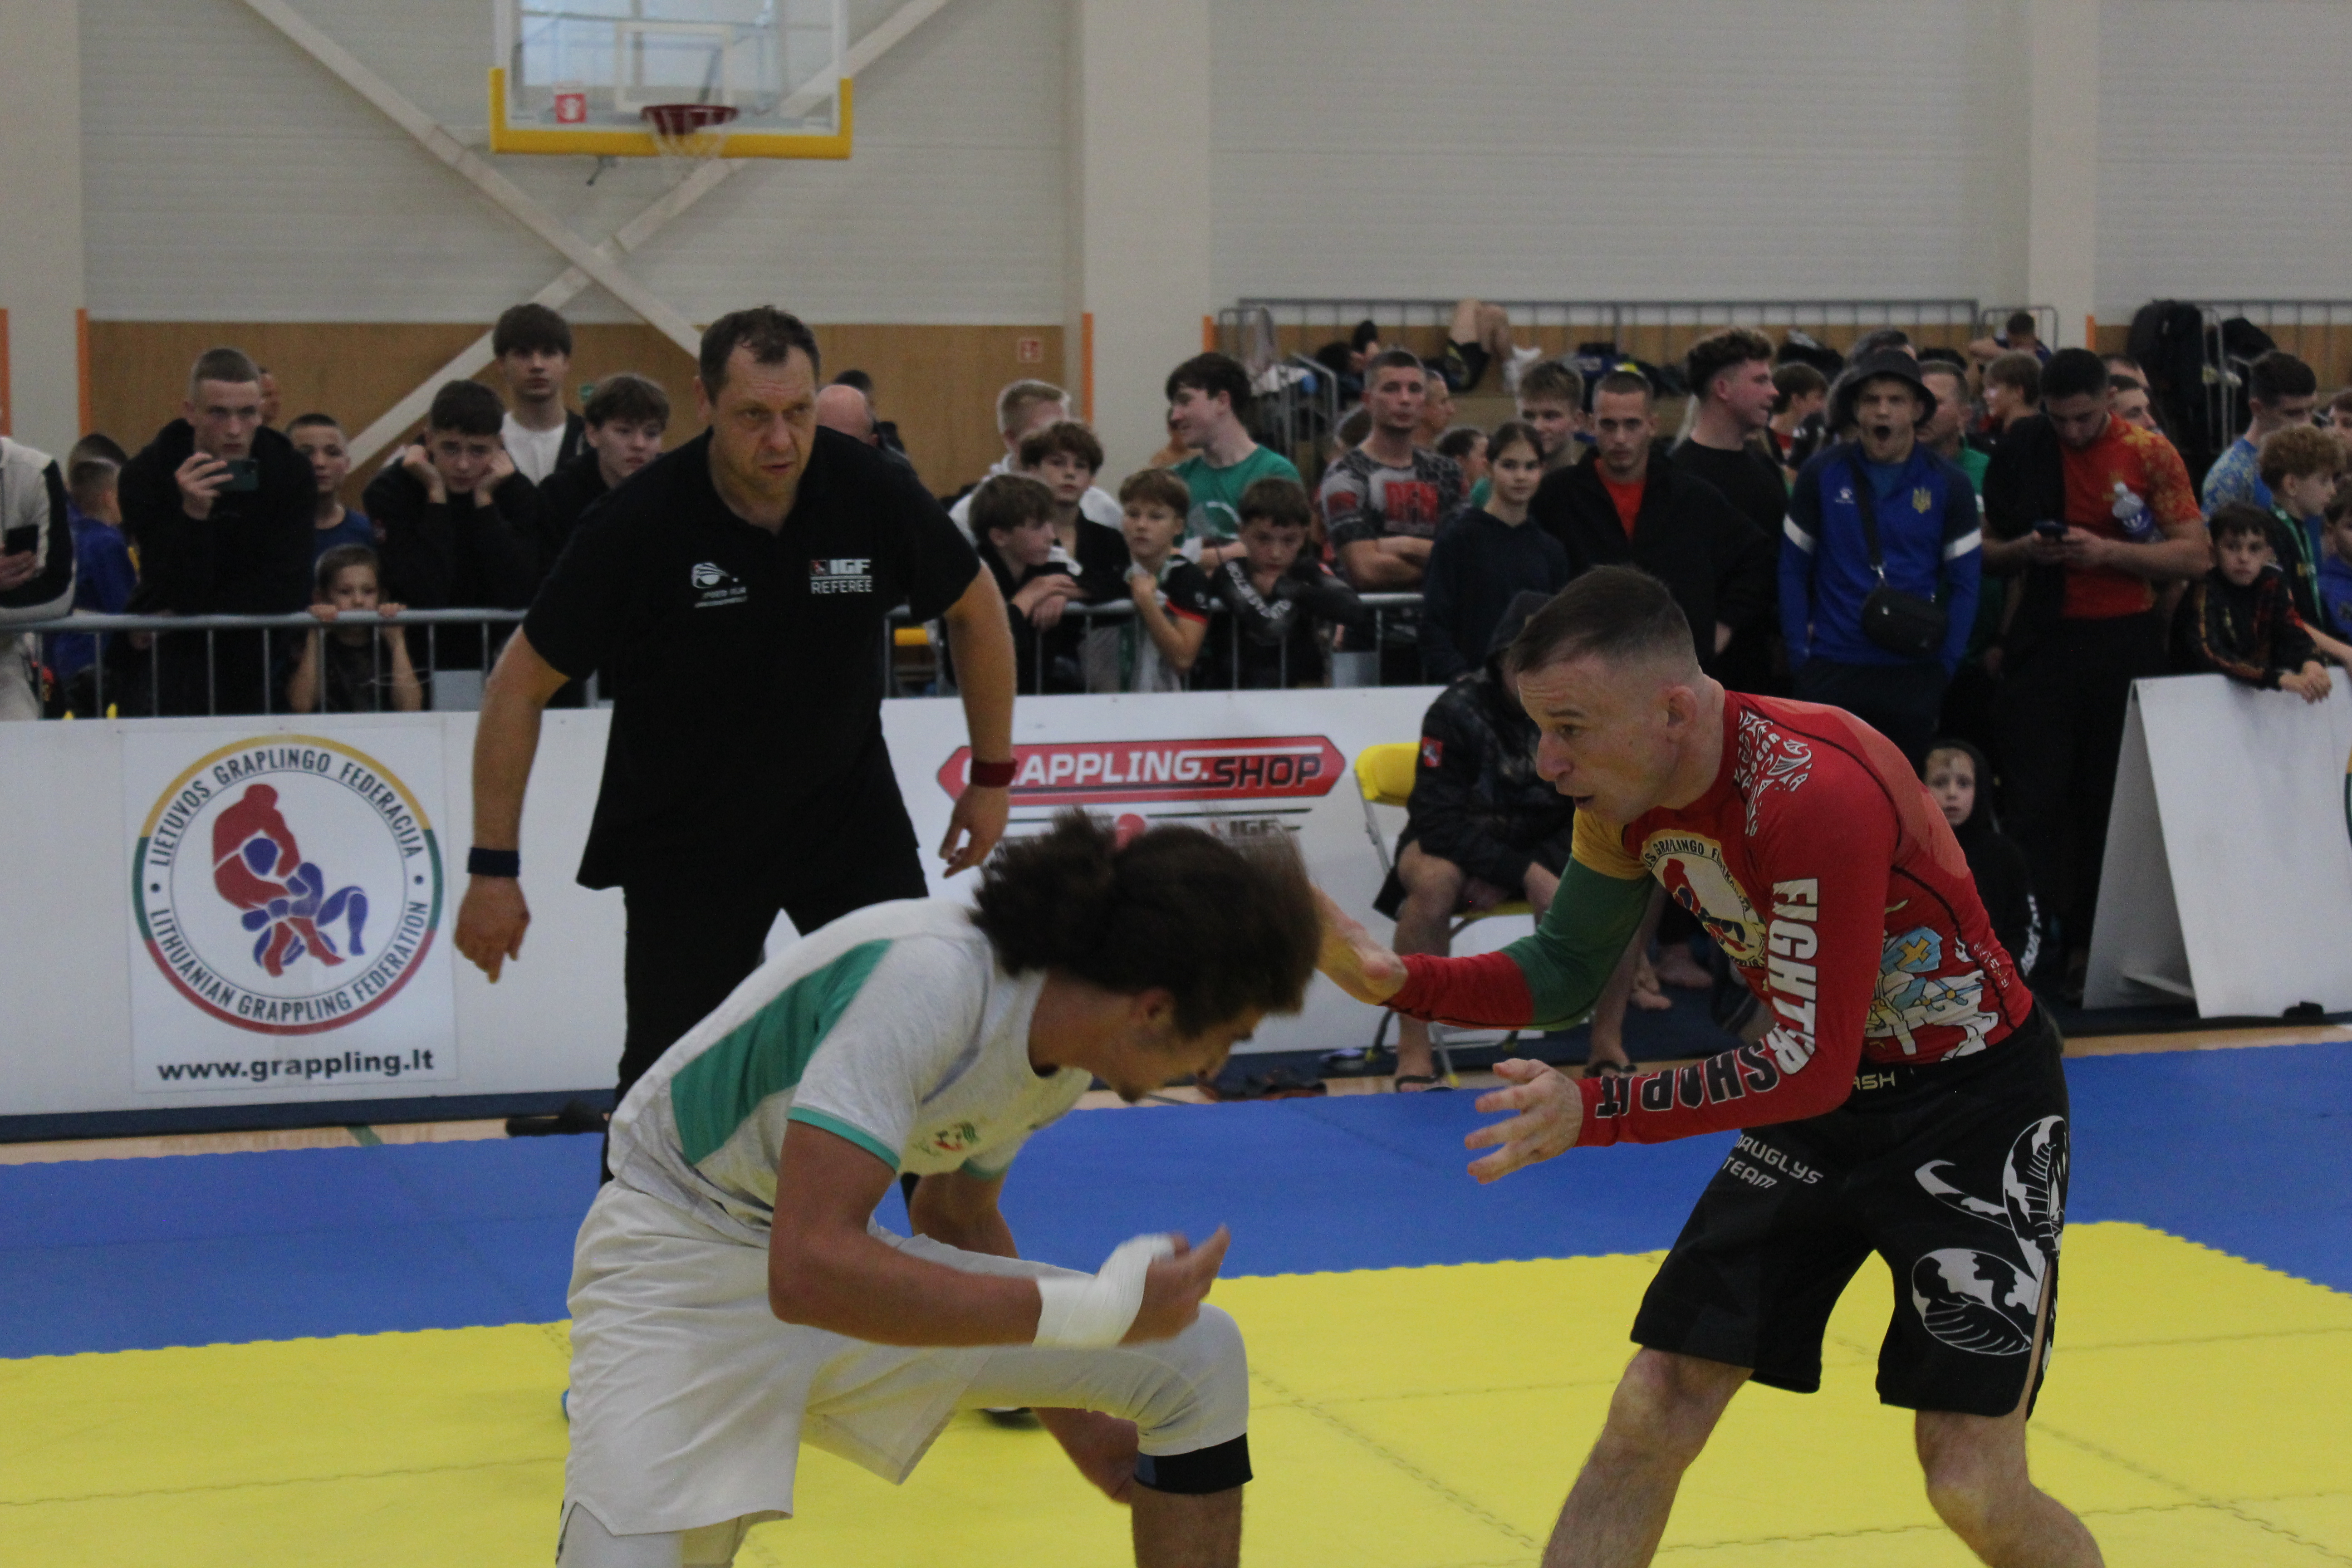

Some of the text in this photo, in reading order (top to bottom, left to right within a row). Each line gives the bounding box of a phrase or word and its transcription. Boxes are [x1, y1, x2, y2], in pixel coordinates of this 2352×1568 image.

[830, 559, 872, 574] IGF
[811, 580, 872, 593] REFEREE
[961, 750, 1322, 788] APPLING.SHOP
[150, 748, 423, 867] LIETUVOS GRAPLINGO FEDERACIJA
[150, 901, 428, 1023] LITHUANIAN GRAPPLING FEDERATION
[157, 1049, 434, 1082] www.grappling.lt
[1722, 1156, 1778, 1188] TEAM
